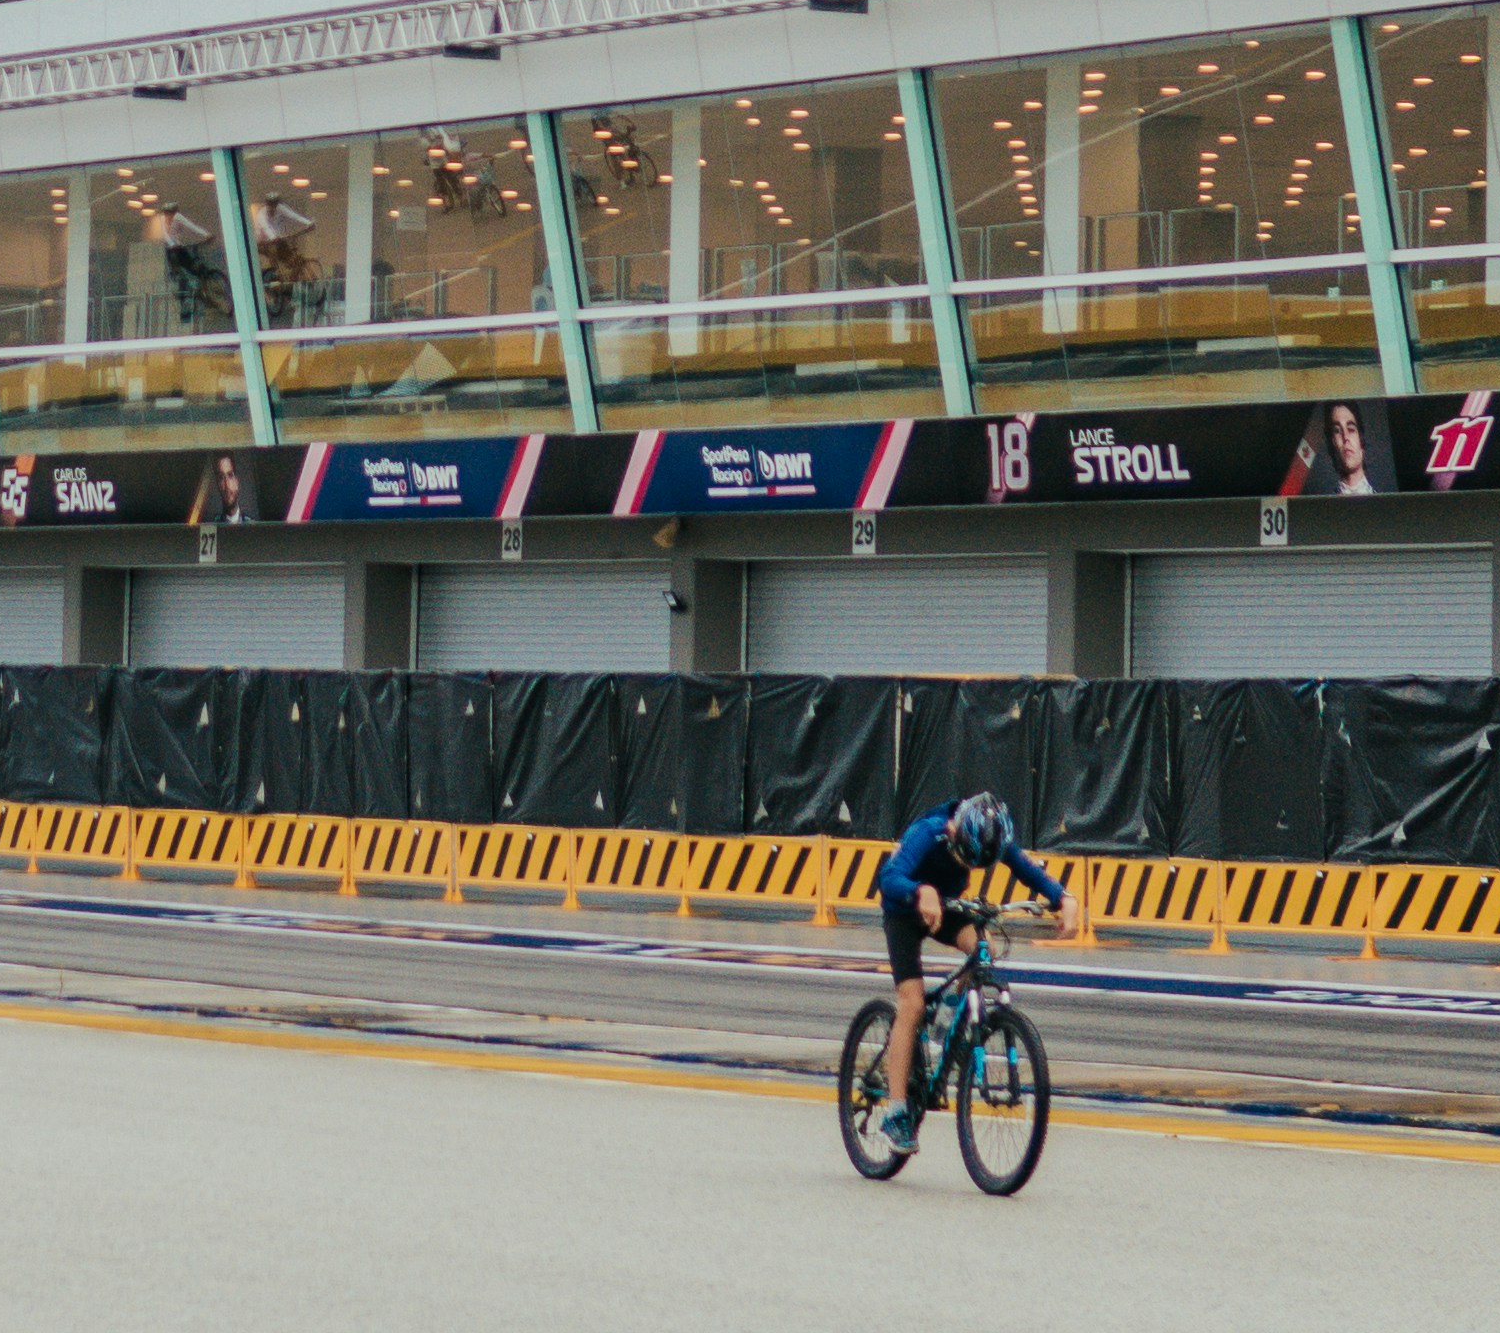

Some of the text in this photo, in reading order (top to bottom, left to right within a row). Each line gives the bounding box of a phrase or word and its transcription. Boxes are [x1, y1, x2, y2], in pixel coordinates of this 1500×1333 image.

[1069, 428, 1116, 447] LANCE
[1426, 415, 1494, 472] 11
[773, 452, 812, 479] BWT
[987, 422, 1030, 492] 18
[1073, 444, 1191, 483] STROLL
[53, 467, 88, 482] CARLOS
[372, 477, 399, 495] Racing
[426, 465, 459, 490] BWT
[712, 466, 743, 485] Racing
[1, 468, 29, 517] 55
[56, 480, 116, 513] SAINZ
[854, 520, 875, 546] 29
[1263, 508, 1286, 536] 30
[201, 533, 216, 555] 27
[503, 527, 521, 552] 28
